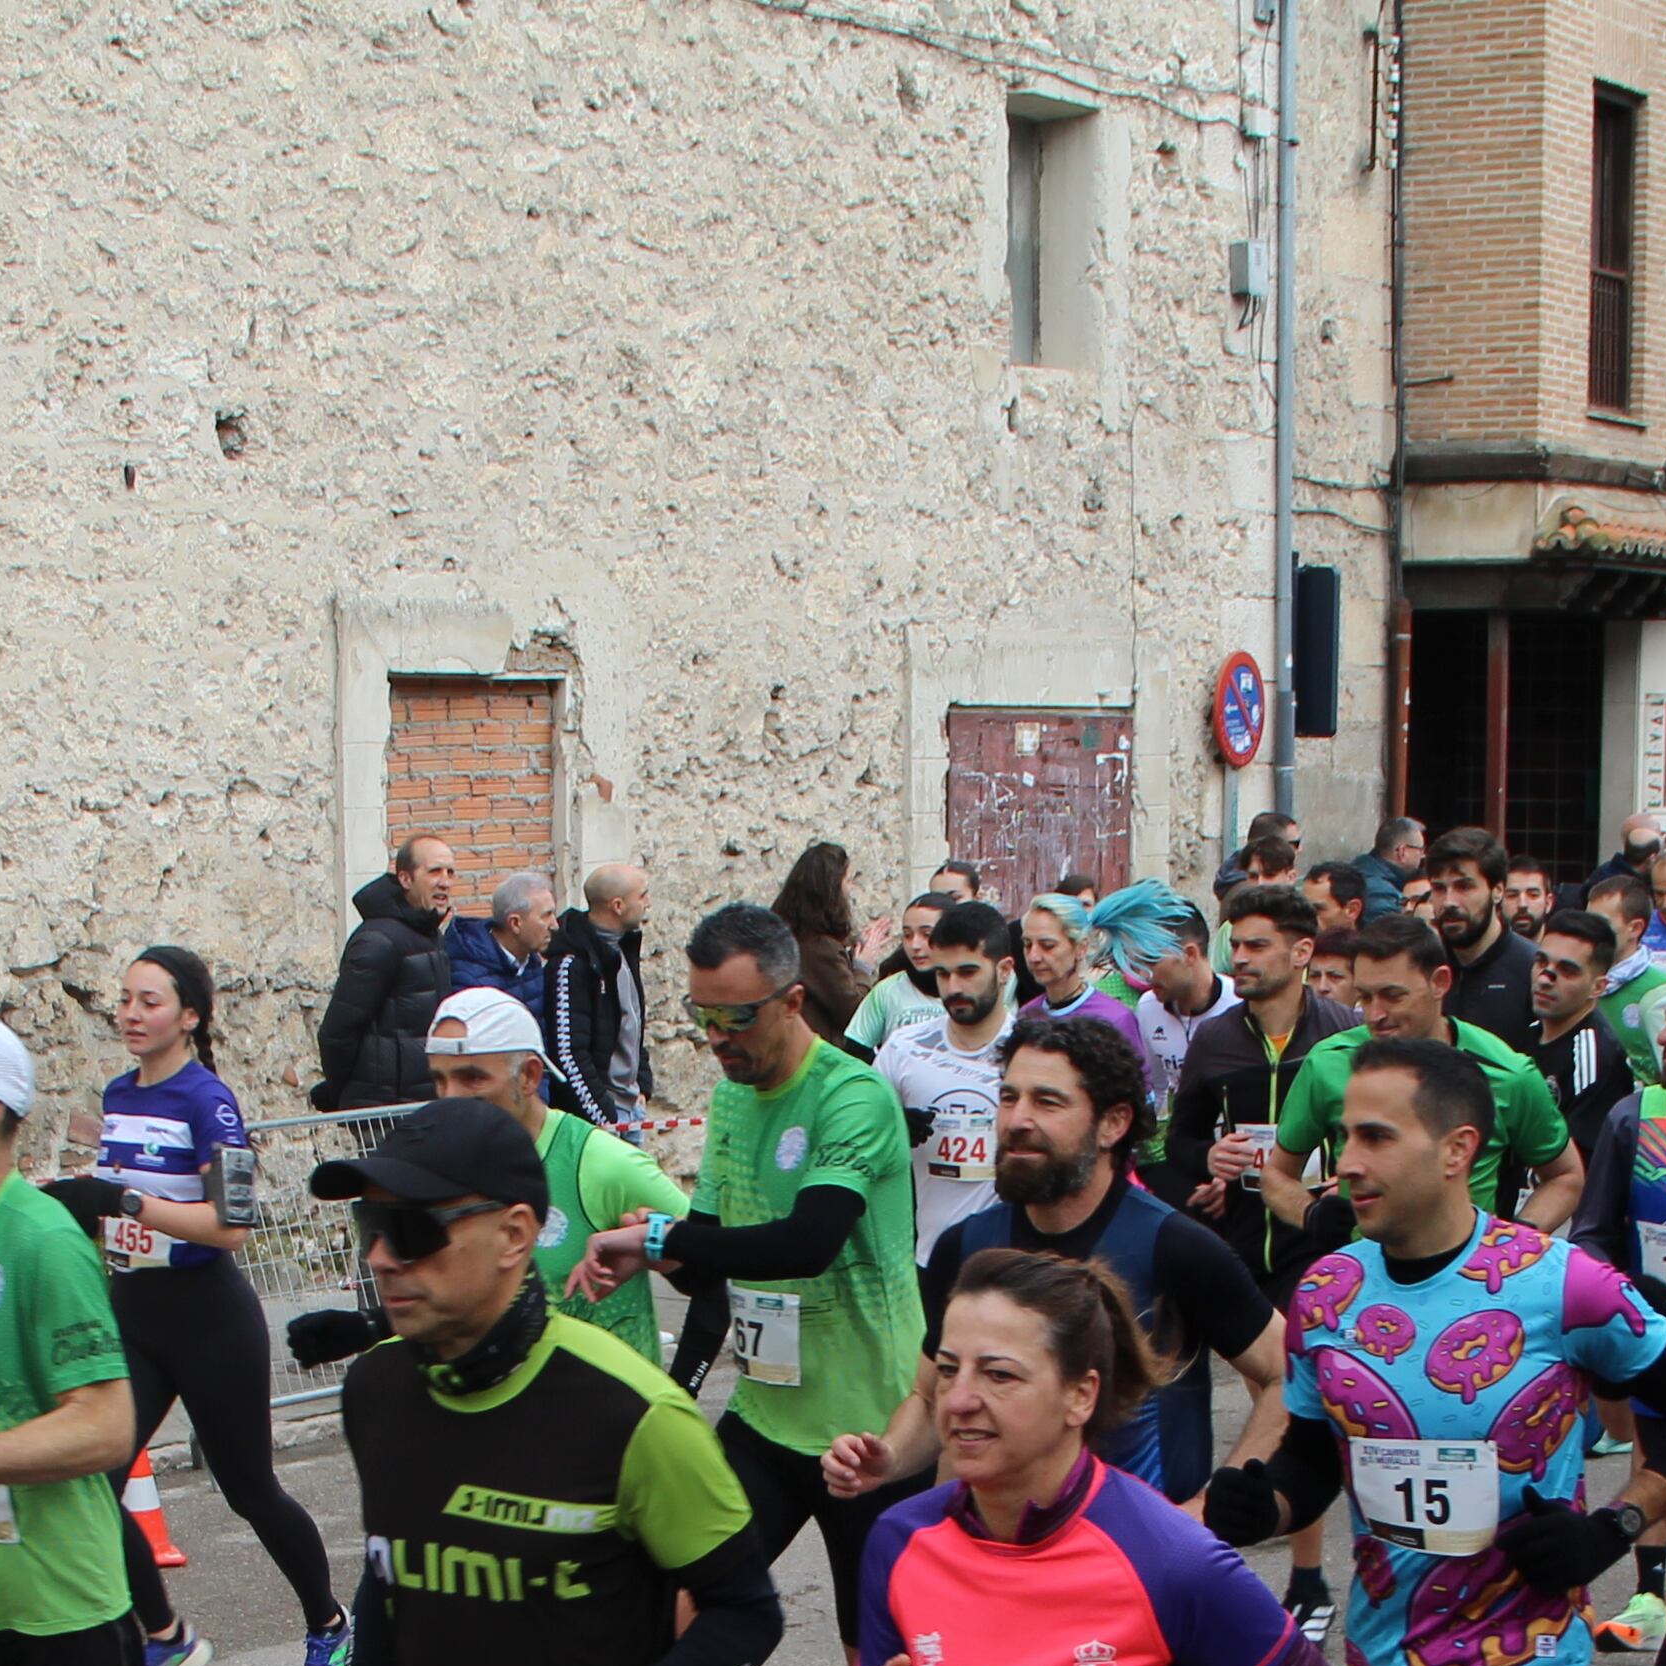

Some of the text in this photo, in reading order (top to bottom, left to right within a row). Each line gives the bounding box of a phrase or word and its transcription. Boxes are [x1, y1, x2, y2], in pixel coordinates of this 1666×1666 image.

[937, 1136, 987, 1163] 424
[114, 1221, 154, 1254] 455
[1394, 1477, 1451, 1525] 15
